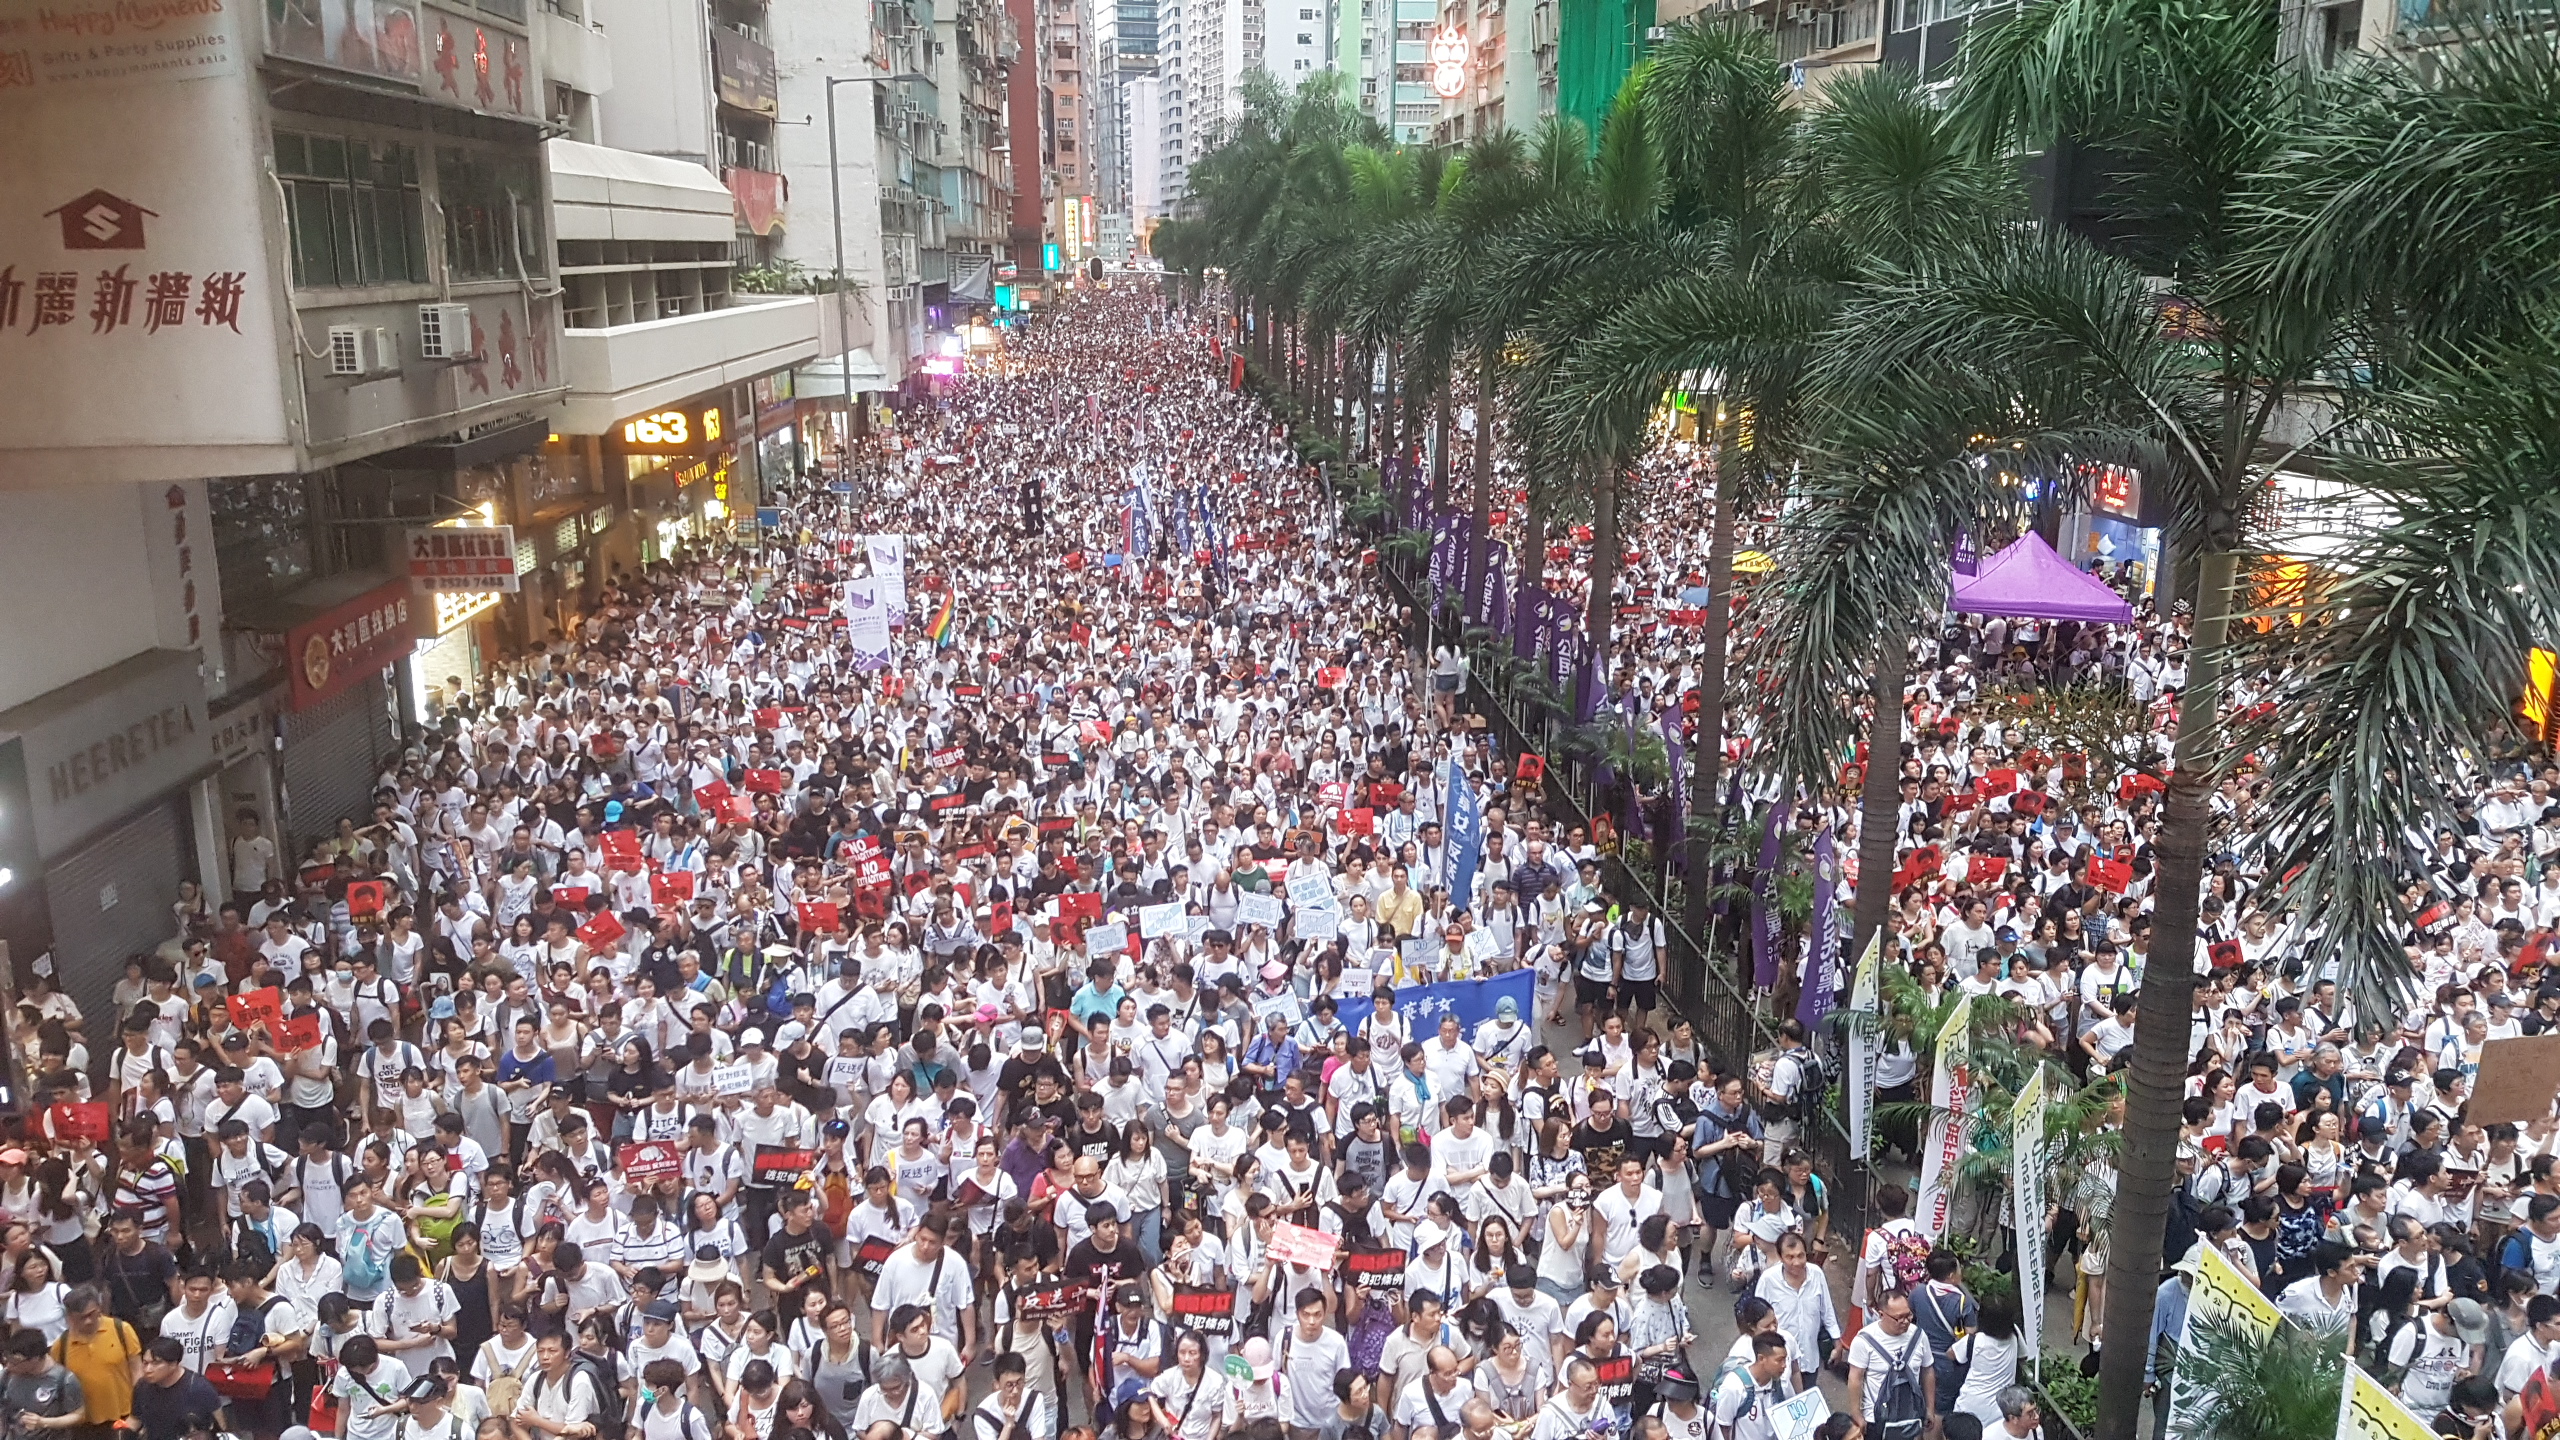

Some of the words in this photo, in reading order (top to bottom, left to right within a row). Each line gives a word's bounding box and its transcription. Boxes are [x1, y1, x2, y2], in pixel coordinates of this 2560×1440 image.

[154, 33, 227, 52] Supplies
[625, 412, 688, 443] 163
[848, 839, 866, 855] NO
[861, 860, 878, 875] NO
[1400, 995, 1455, 1021] 英華女
[764, 1169, 799, 1184] 逃犯條
[900, 1164, 932, 1179] 反送中
[1358, 1271, 1405, 1287] 逃犯條例
[1024, 1285, 1088, 1311] 反送中
[1183, 1312, 1231, 1331] 逃犯條例
[187, 1345, 215, 1354] DEIM
[1596, 1382, 1633, 1398] 犯條例
[1787, 1399, 1808, 1421] NO
